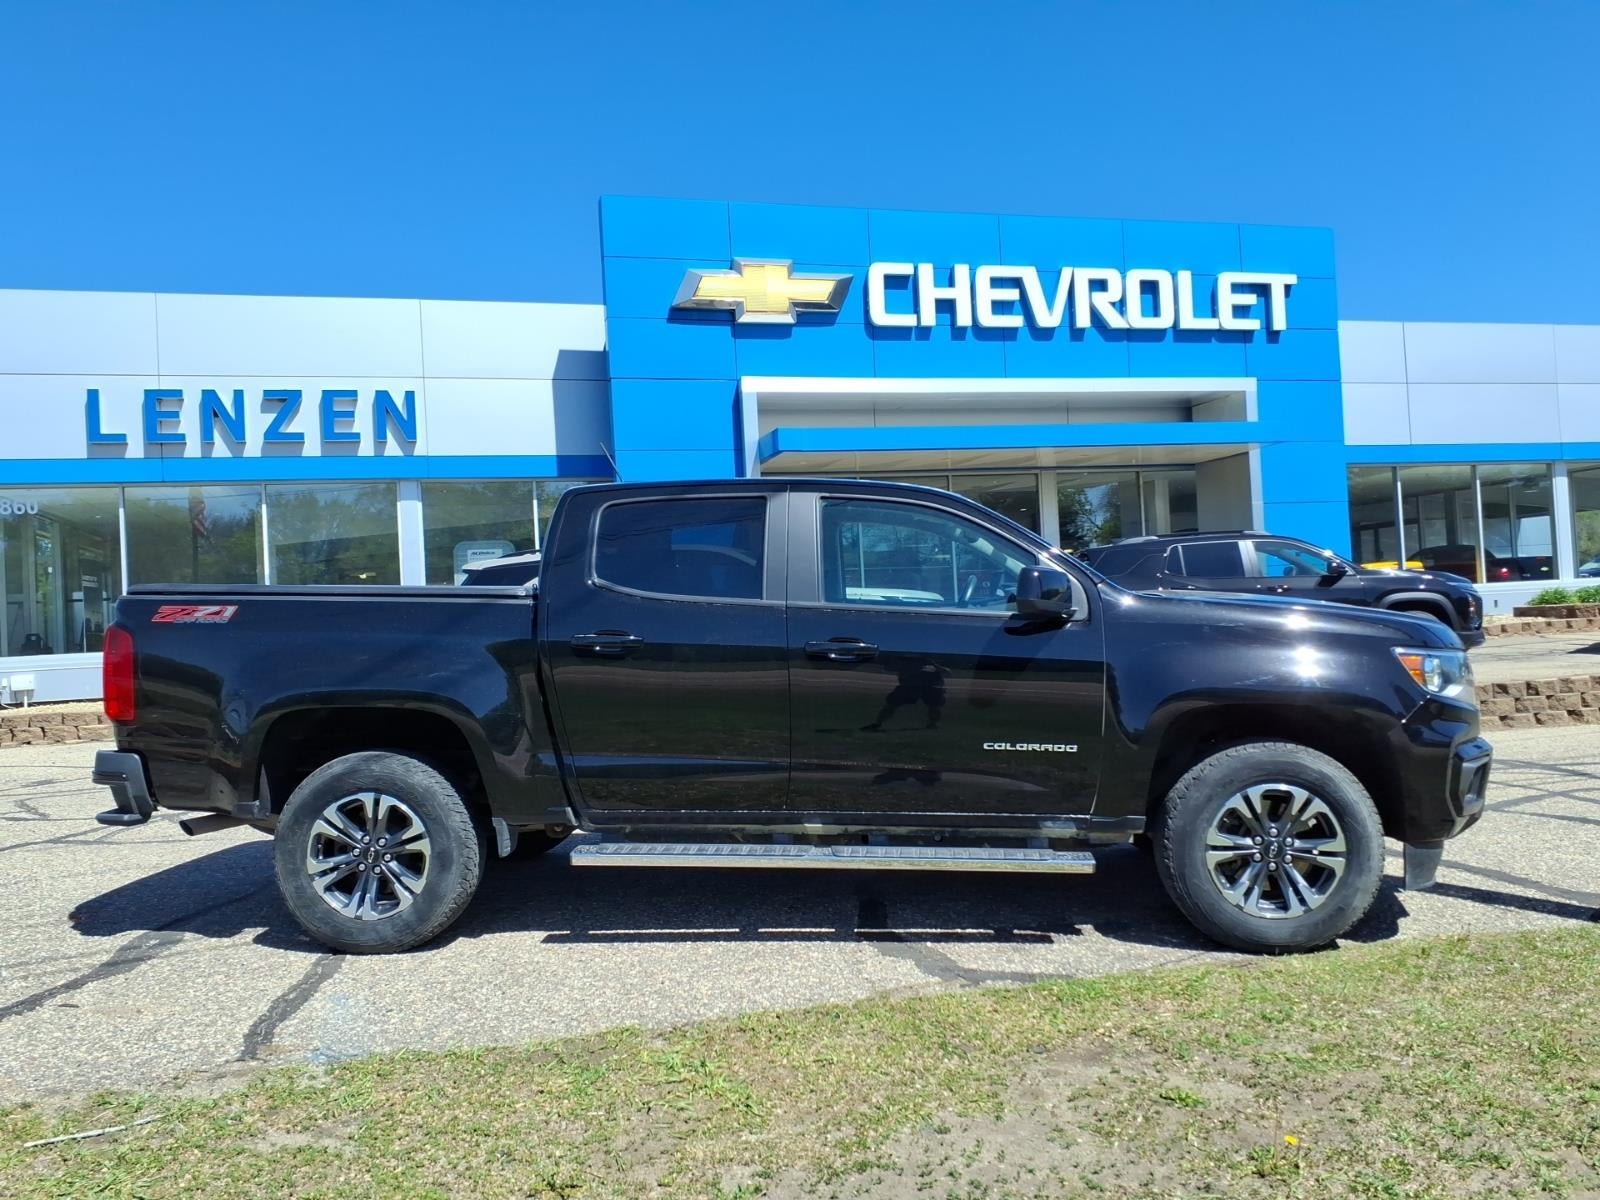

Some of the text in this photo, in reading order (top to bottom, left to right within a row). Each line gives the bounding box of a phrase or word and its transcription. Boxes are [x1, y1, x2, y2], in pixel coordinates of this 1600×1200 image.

[867, 262, 1298, 331] CHEVROLET
[86, 389, 417, 443] LENZEN
[151, 605, 238, 621] Z71
[983, 742, 1078, 752] COLORADO
